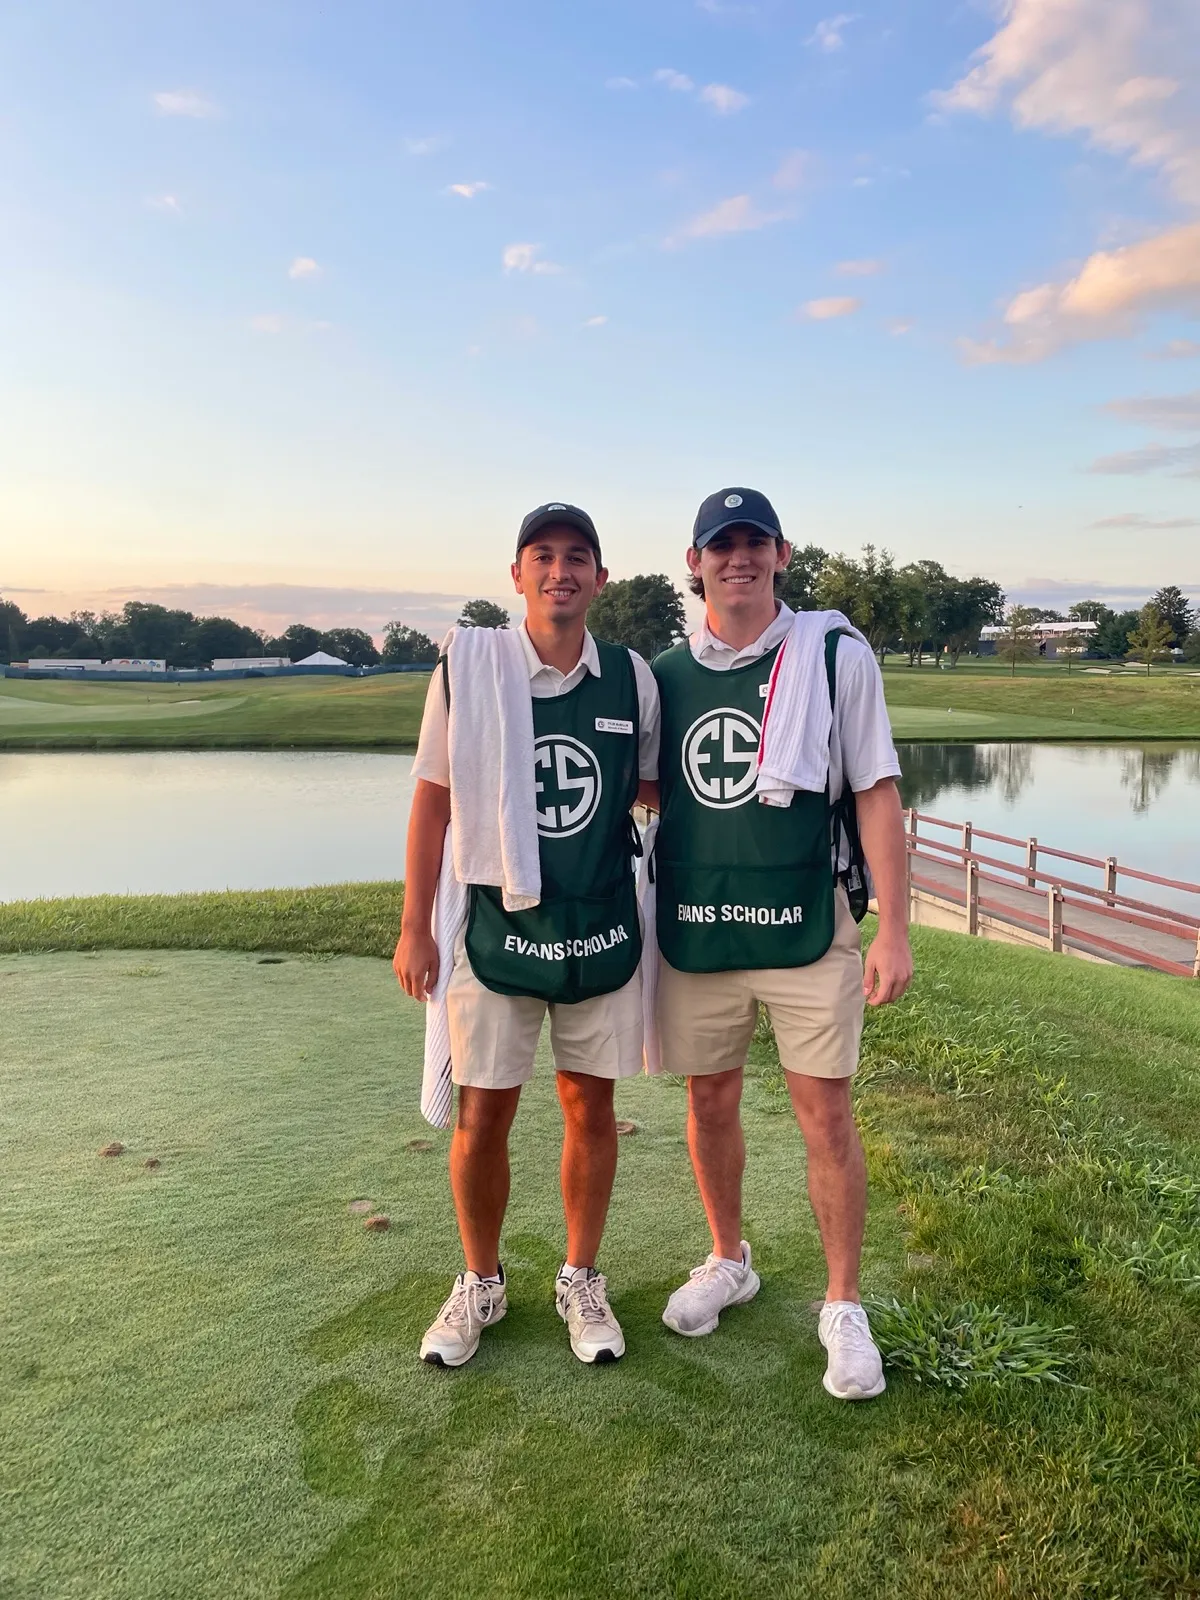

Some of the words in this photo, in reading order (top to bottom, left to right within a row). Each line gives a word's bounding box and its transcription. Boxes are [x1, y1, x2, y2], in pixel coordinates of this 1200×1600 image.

[688, 717, 760, 800] ES
[678, 903, 716, 923] EVANS
[720, 904, 802, 925] SCHOLAR
[503, 934, 566, 961] EVANS
[566, 924, 629, 958] SCHOLAR
